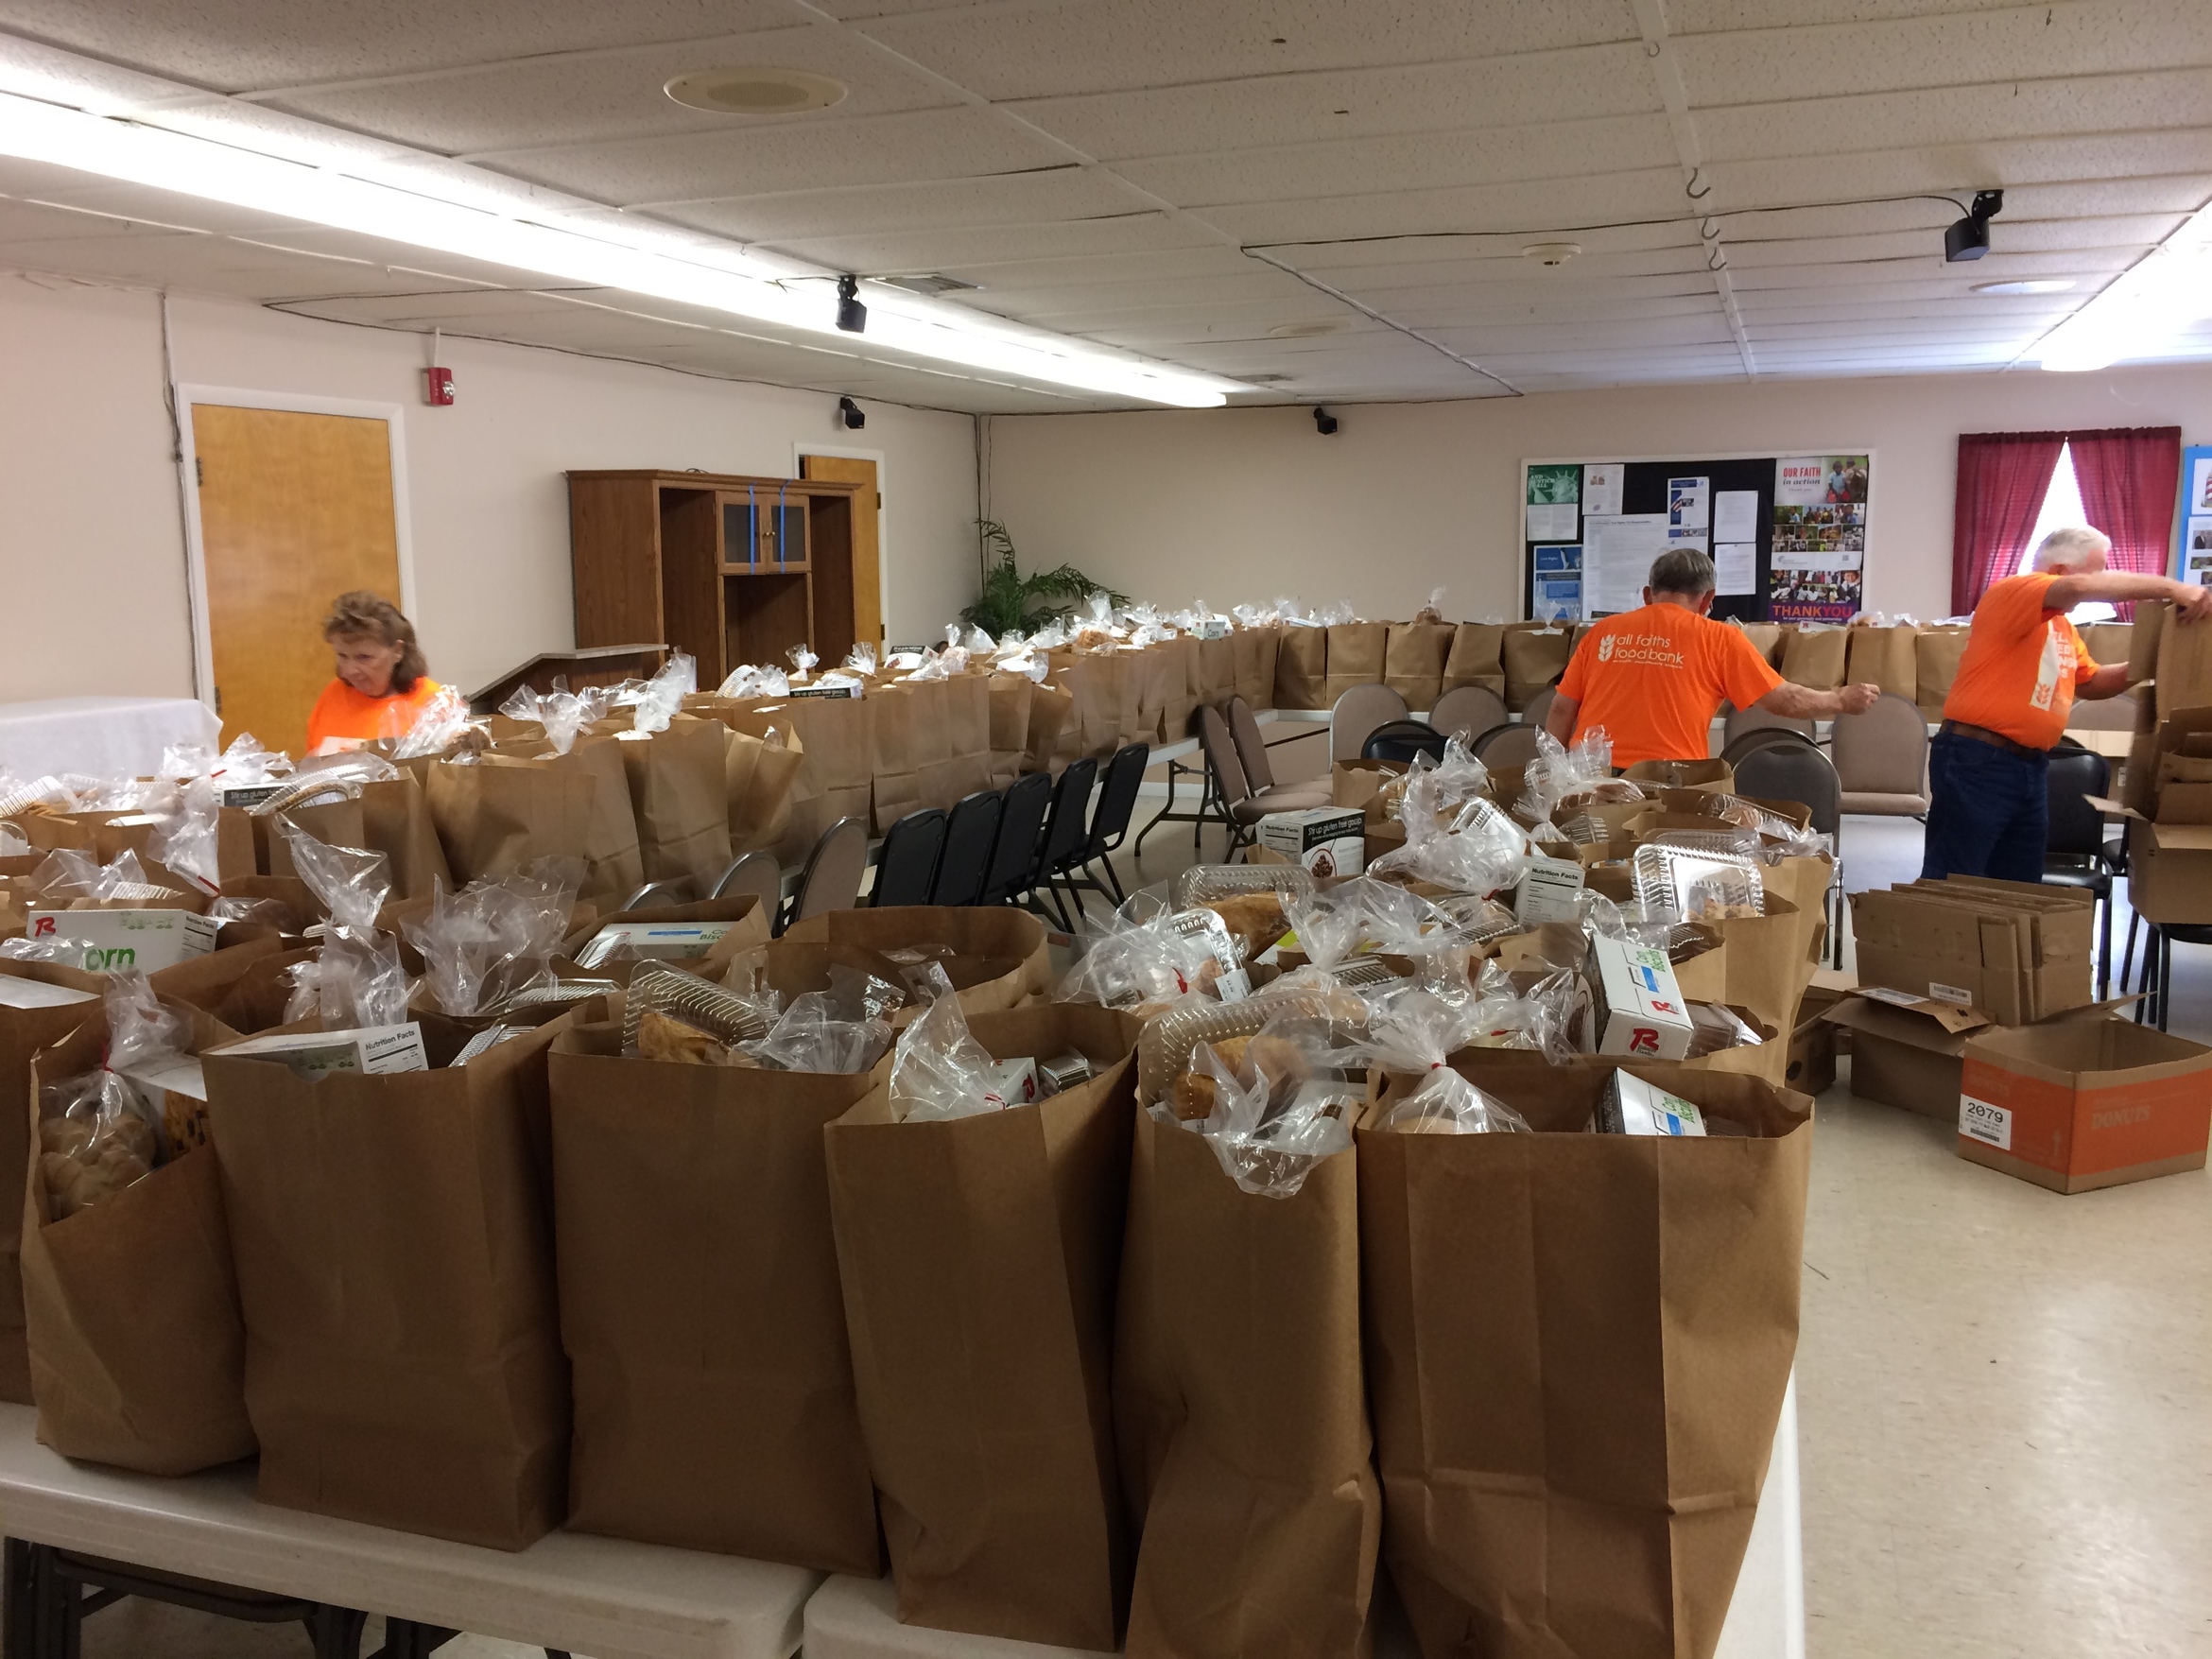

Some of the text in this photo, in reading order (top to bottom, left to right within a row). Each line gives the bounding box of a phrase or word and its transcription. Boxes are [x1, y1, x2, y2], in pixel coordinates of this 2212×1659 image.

[1783, 467, 1821, 477] OUR FAITH
[1616, 634, 1670, 648] all faiths
[1615, 648, 1684, 664] food bank
[1316, 826, 1322, 835] up
[1323, 822, 1338, 834] gluten
[1339, 820, 1347, 828] free
[1532, 868, 1560, 877] Nutrition
[186, 916, 202, 925] Nutrition
[85, 947, 136, 971] orn
[365, 1029, 415, 1050] Nutrition Facts
[1967, 1102, 2003, 1123] 2079
